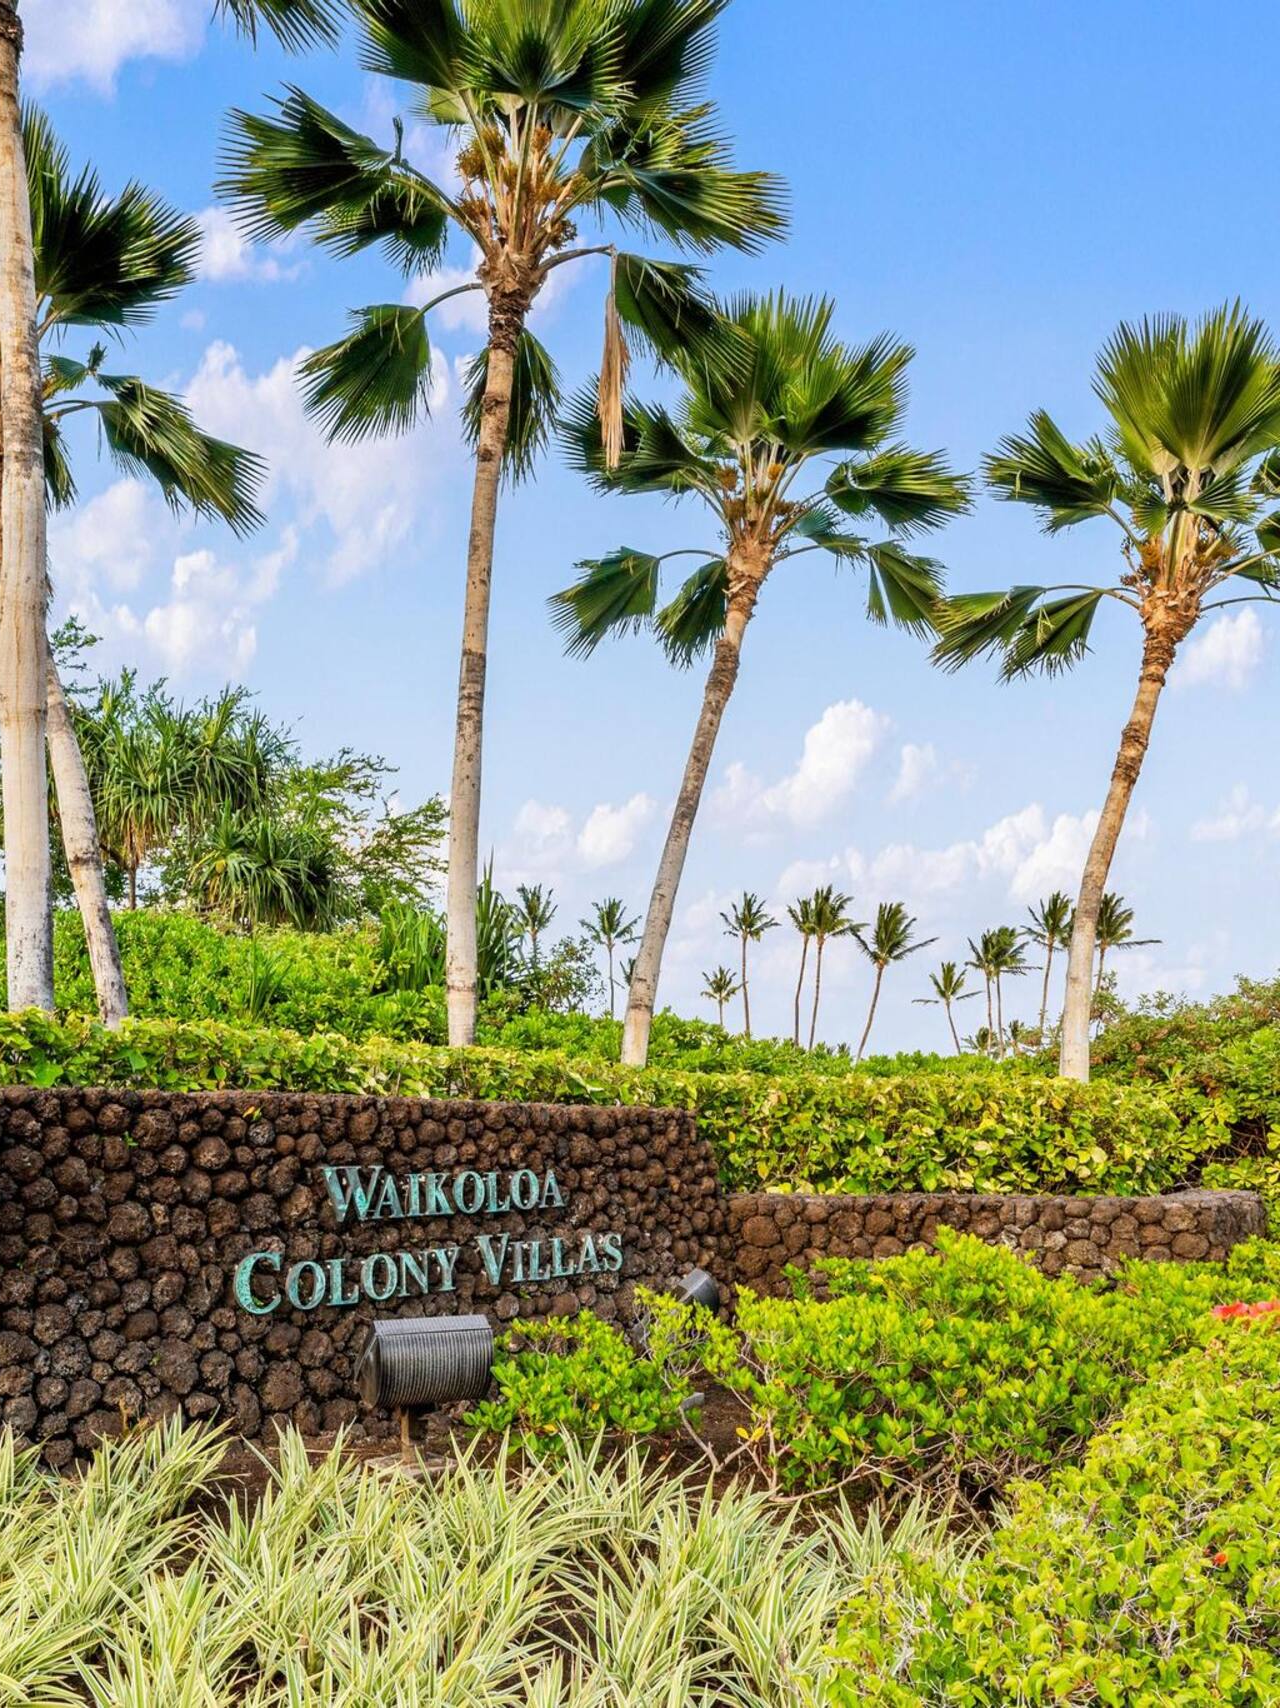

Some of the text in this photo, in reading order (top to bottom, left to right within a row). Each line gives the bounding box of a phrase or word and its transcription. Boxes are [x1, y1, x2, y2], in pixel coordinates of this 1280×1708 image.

[323, 1164, 565, 1221] WAIKOLOA
[233, 1232, 623, 1314] COLONY VILLAS
